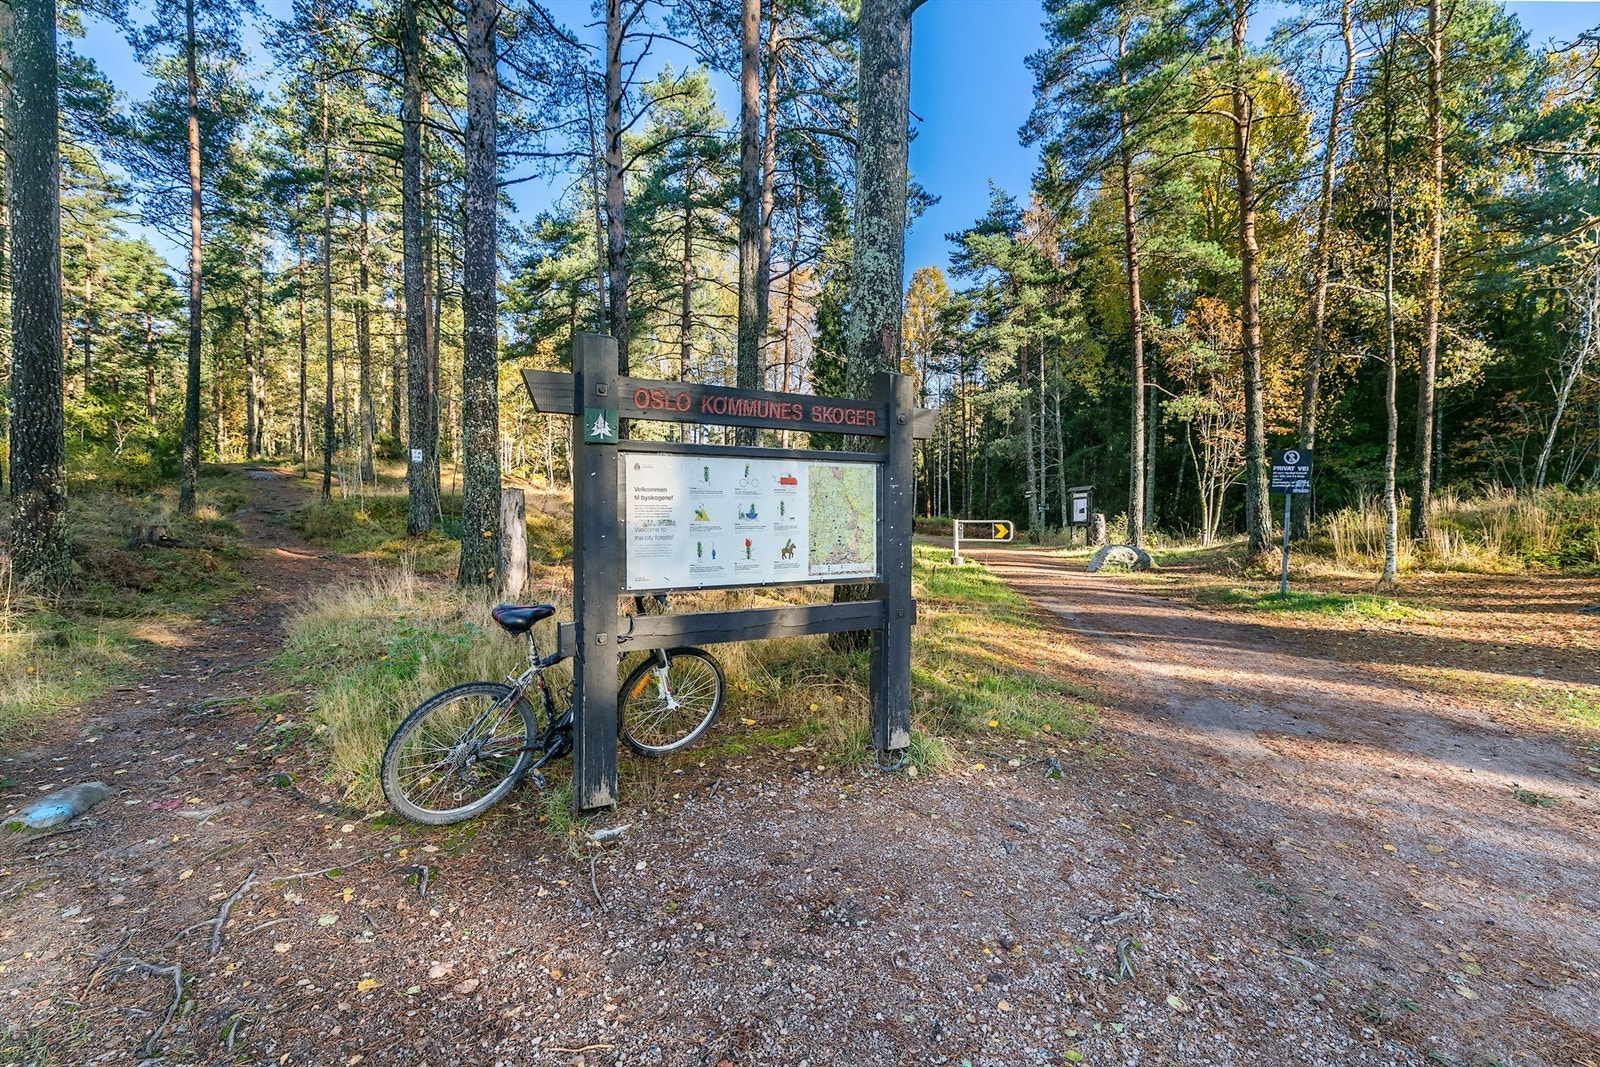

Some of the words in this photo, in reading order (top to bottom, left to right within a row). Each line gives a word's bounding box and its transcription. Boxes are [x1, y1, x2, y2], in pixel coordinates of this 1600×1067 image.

[633, 387, 691, 411] OSLO
[701, 395, 803, 420] KOMMUNES
[811, 405, 877, 426] SKOGER
